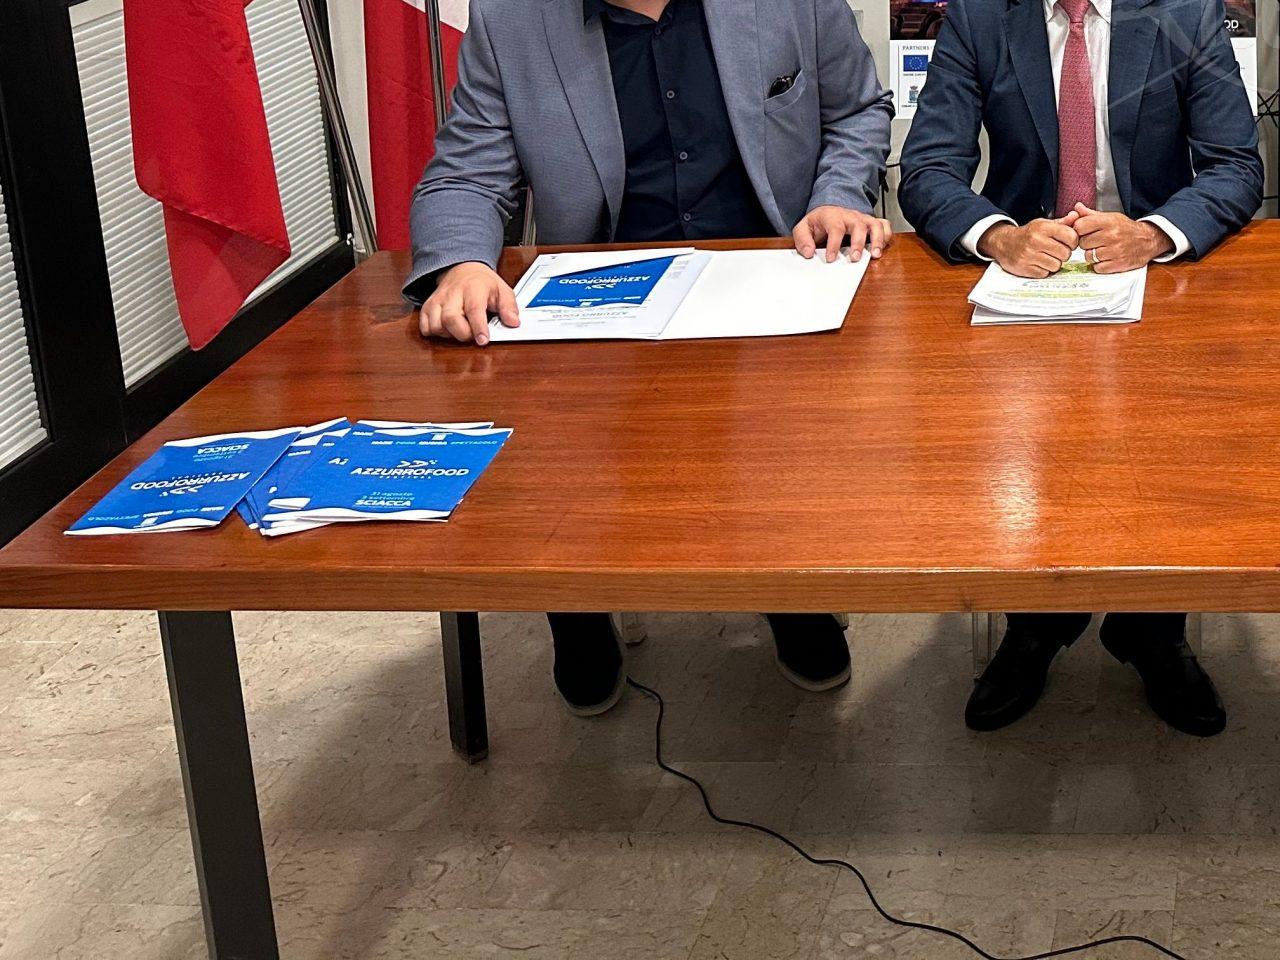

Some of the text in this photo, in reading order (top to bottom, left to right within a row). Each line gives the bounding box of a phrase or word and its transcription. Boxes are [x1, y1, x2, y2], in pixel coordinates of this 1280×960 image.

[197, 443, 250, 455] SCIACCA
[350, 467, 470, 476] AZZURROFOOD
[130, 471, 251, 490] AZZURROFOOD
[354, 499, 412, 507] SCIACCA
